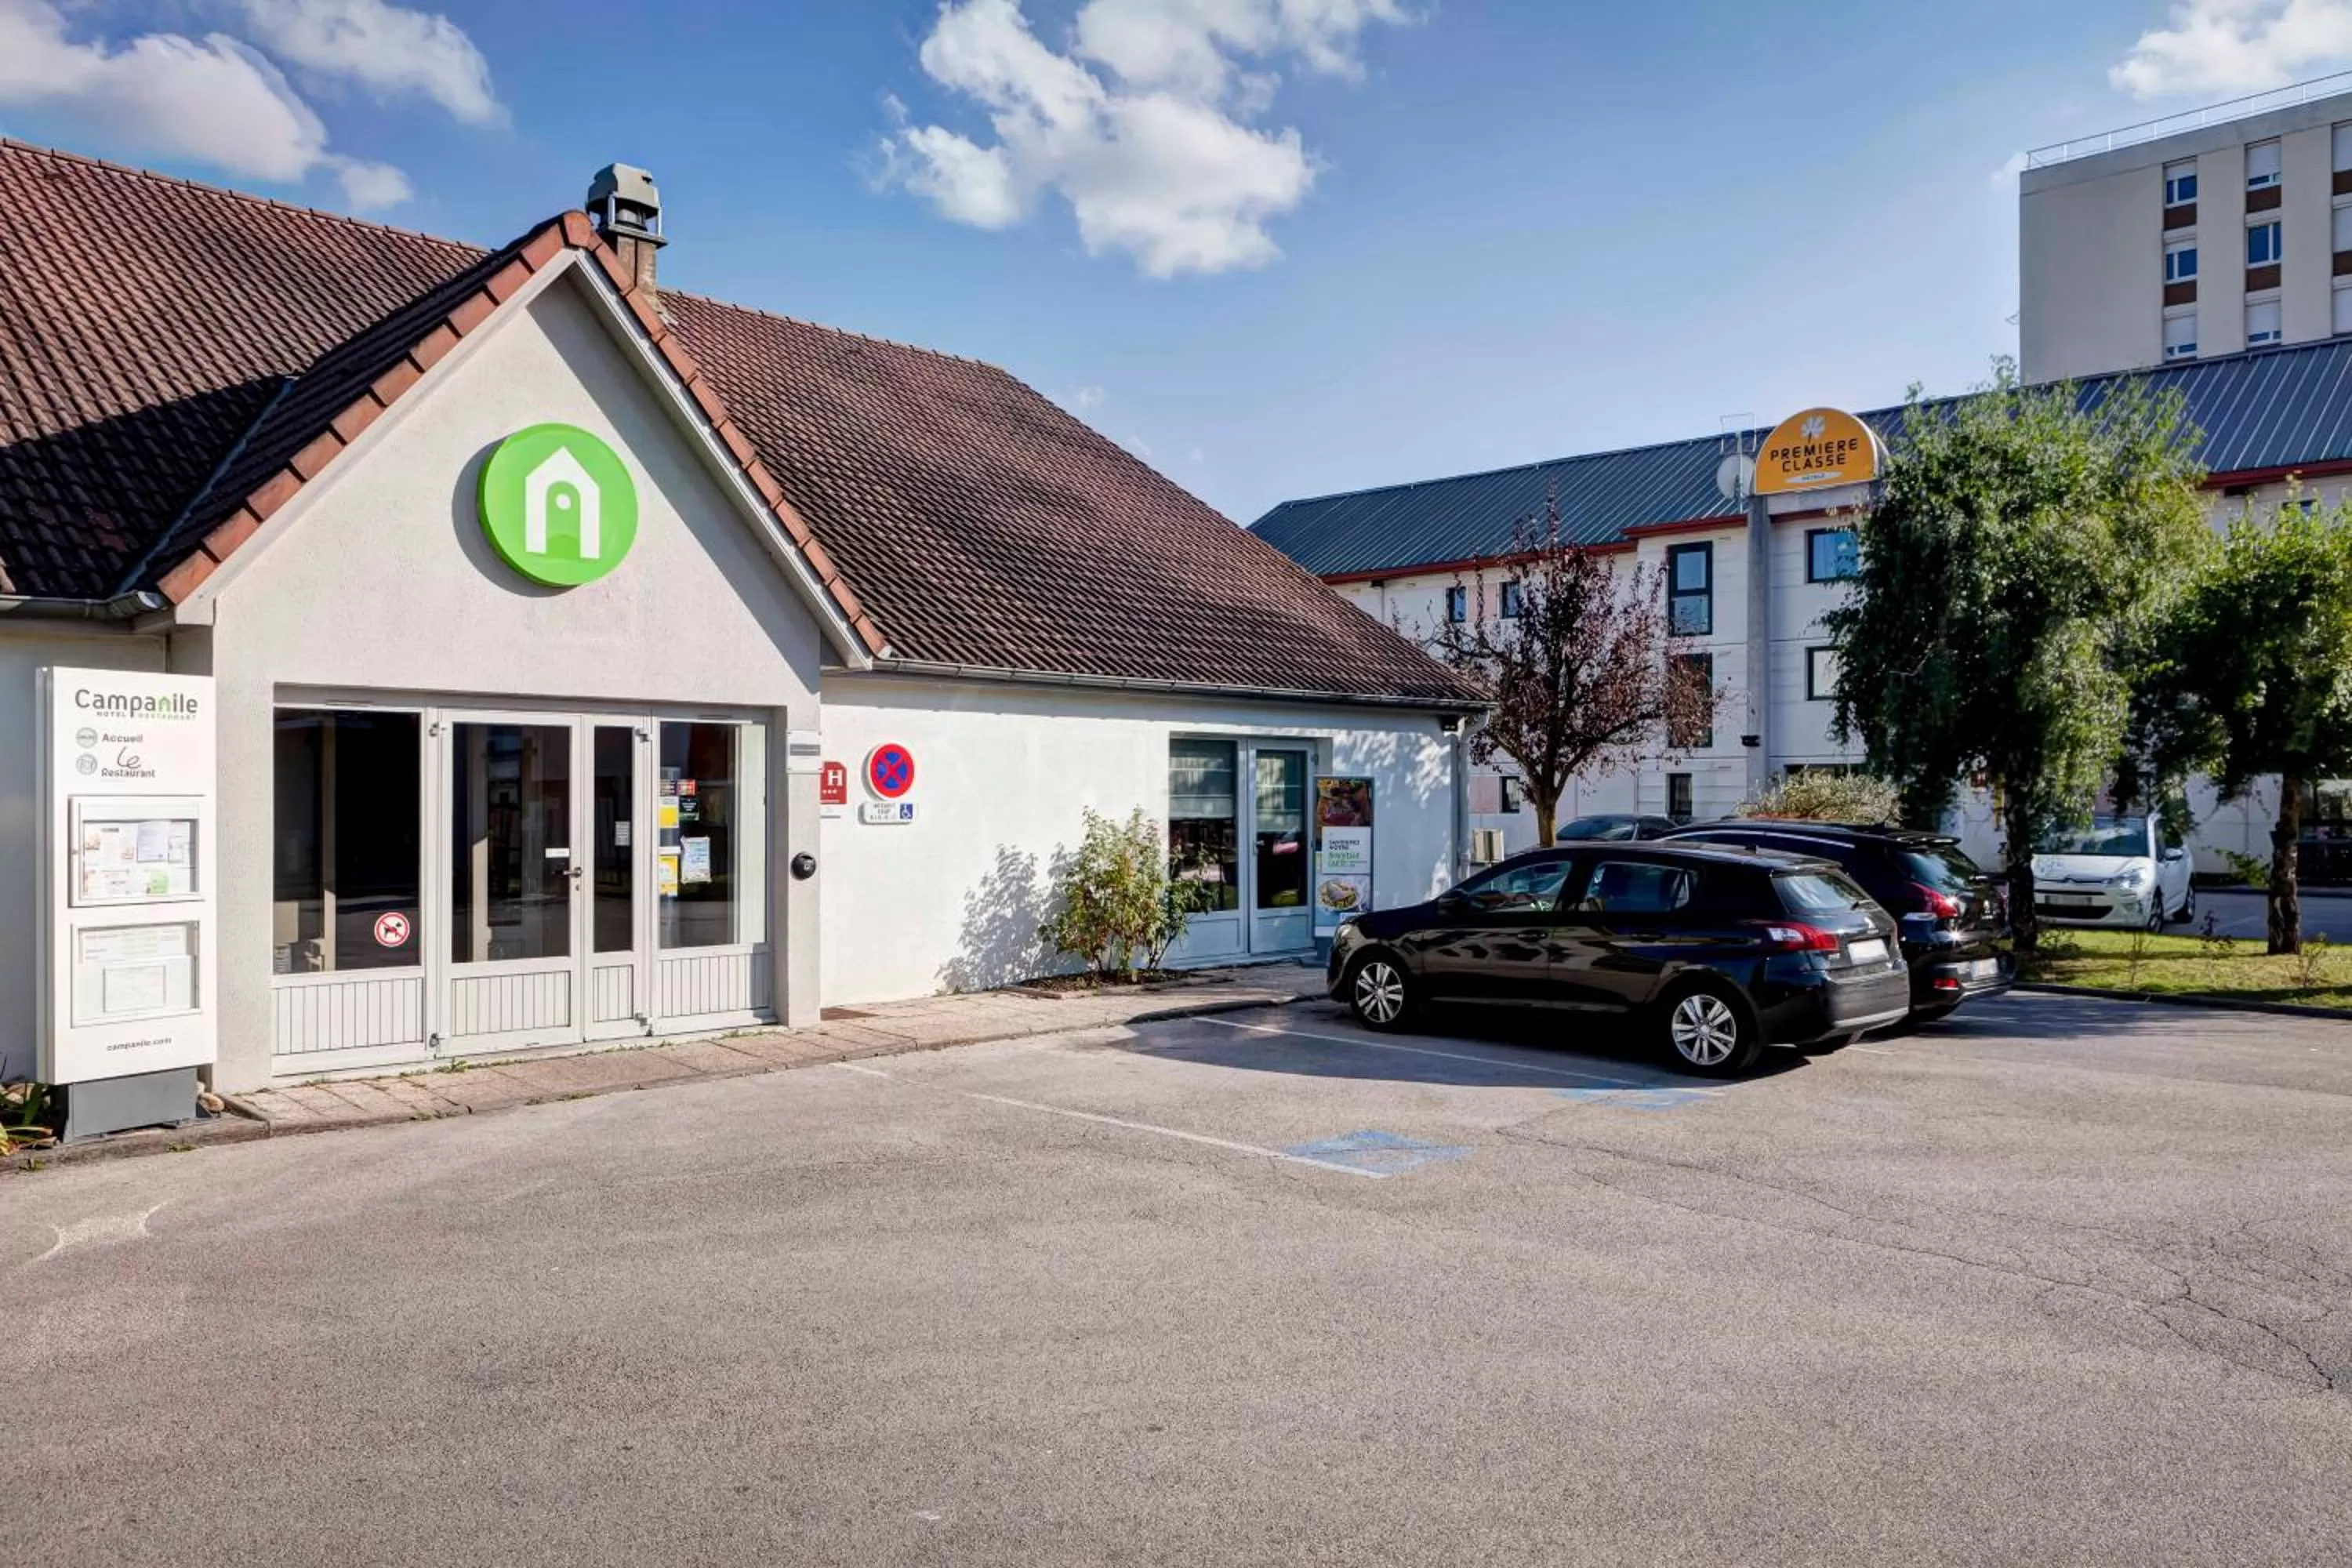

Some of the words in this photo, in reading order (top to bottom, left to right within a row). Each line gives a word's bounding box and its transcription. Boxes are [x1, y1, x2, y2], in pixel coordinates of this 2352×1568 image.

[1770, 438, 1857, 461] PREMIERE
[1782, 453, 1846, 472] CLASSE
[74, 688, 198, 718] Campanile
[101, 733, 143, 743] Accueil
[101, 768, 156, 778] Restaurant
[827, 769, 843, 786] H
